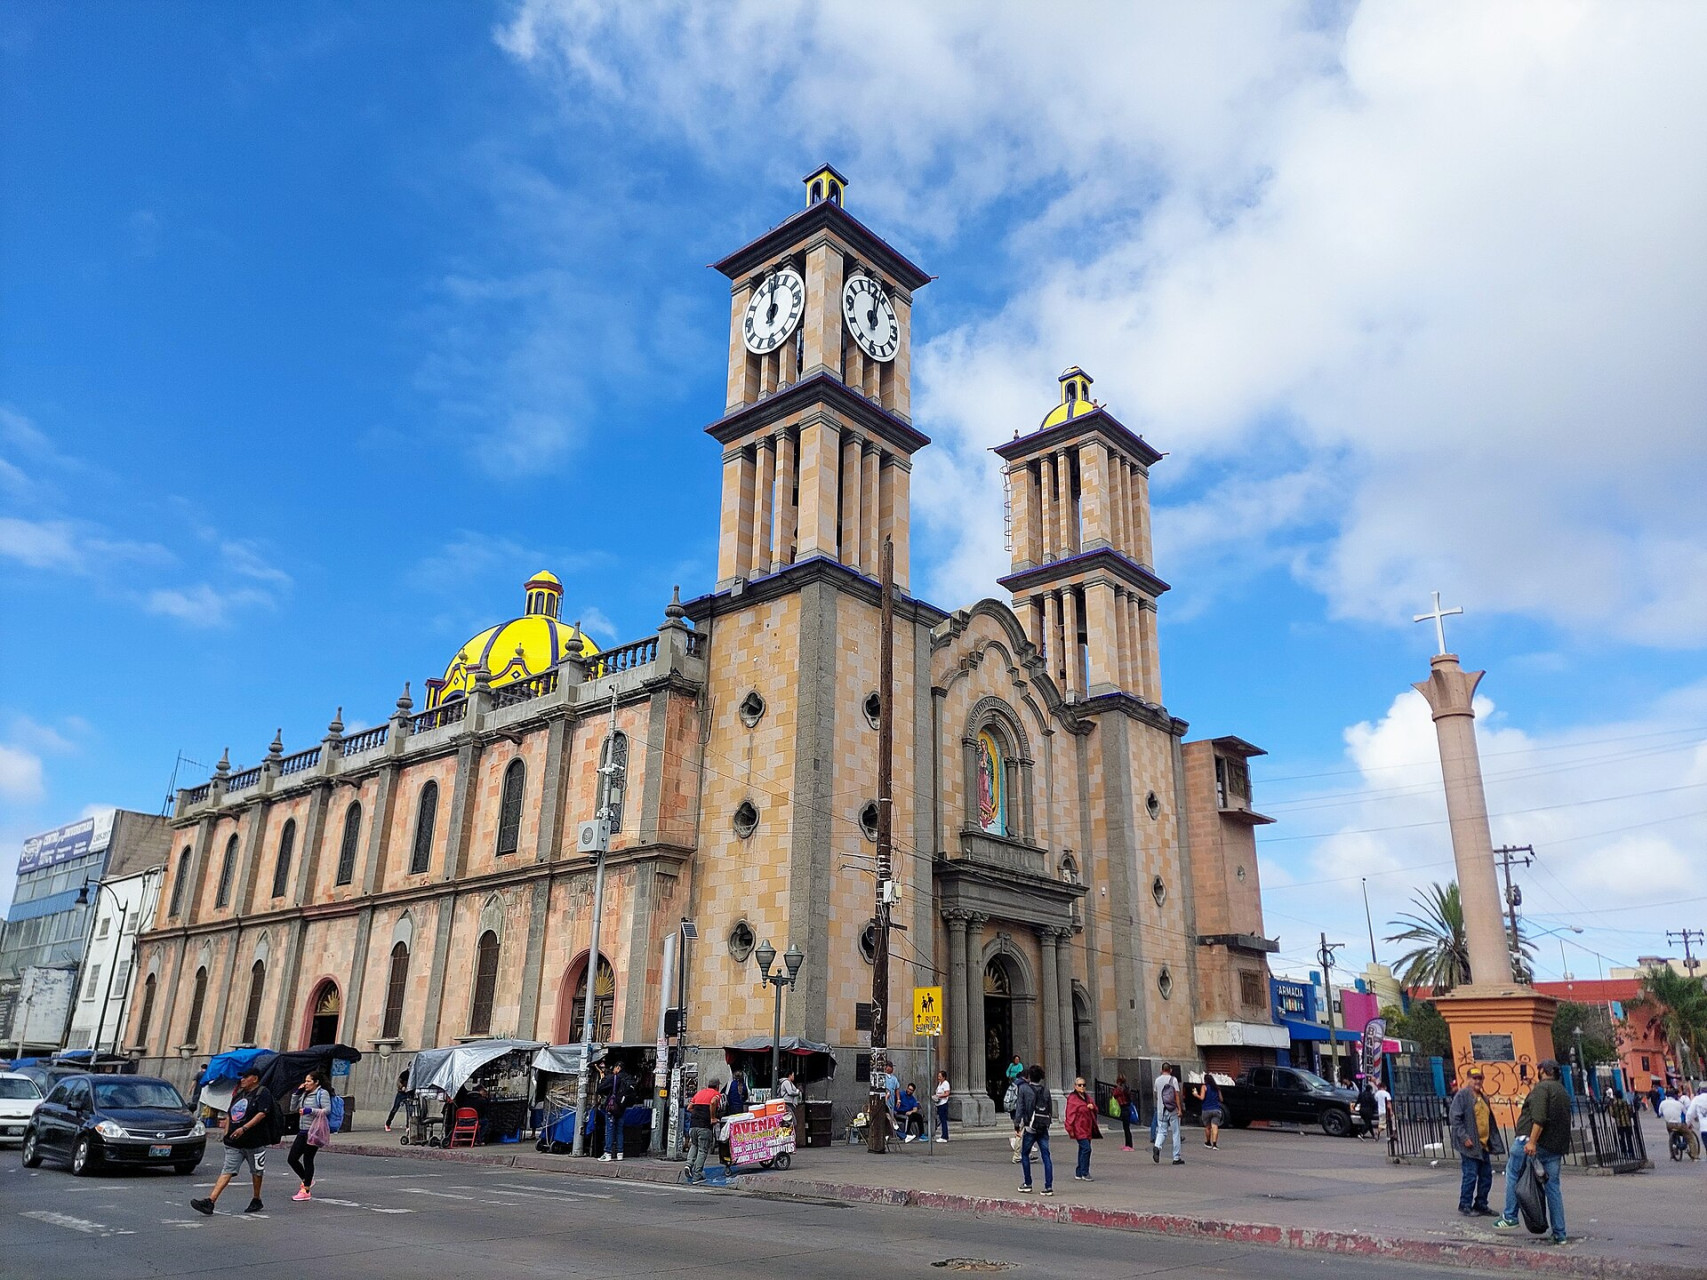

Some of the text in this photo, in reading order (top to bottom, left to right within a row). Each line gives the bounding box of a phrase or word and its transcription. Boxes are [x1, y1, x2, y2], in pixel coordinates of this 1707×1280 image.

[845, 295, 855, 312] 9
[745, 317, 753, 333] 9
[767, 333, 776, 349] 6
[889, 325, 898, 342] 3
[869, 340, 877, 356] 6
[733, 1117, 777, 1136] AVENA
